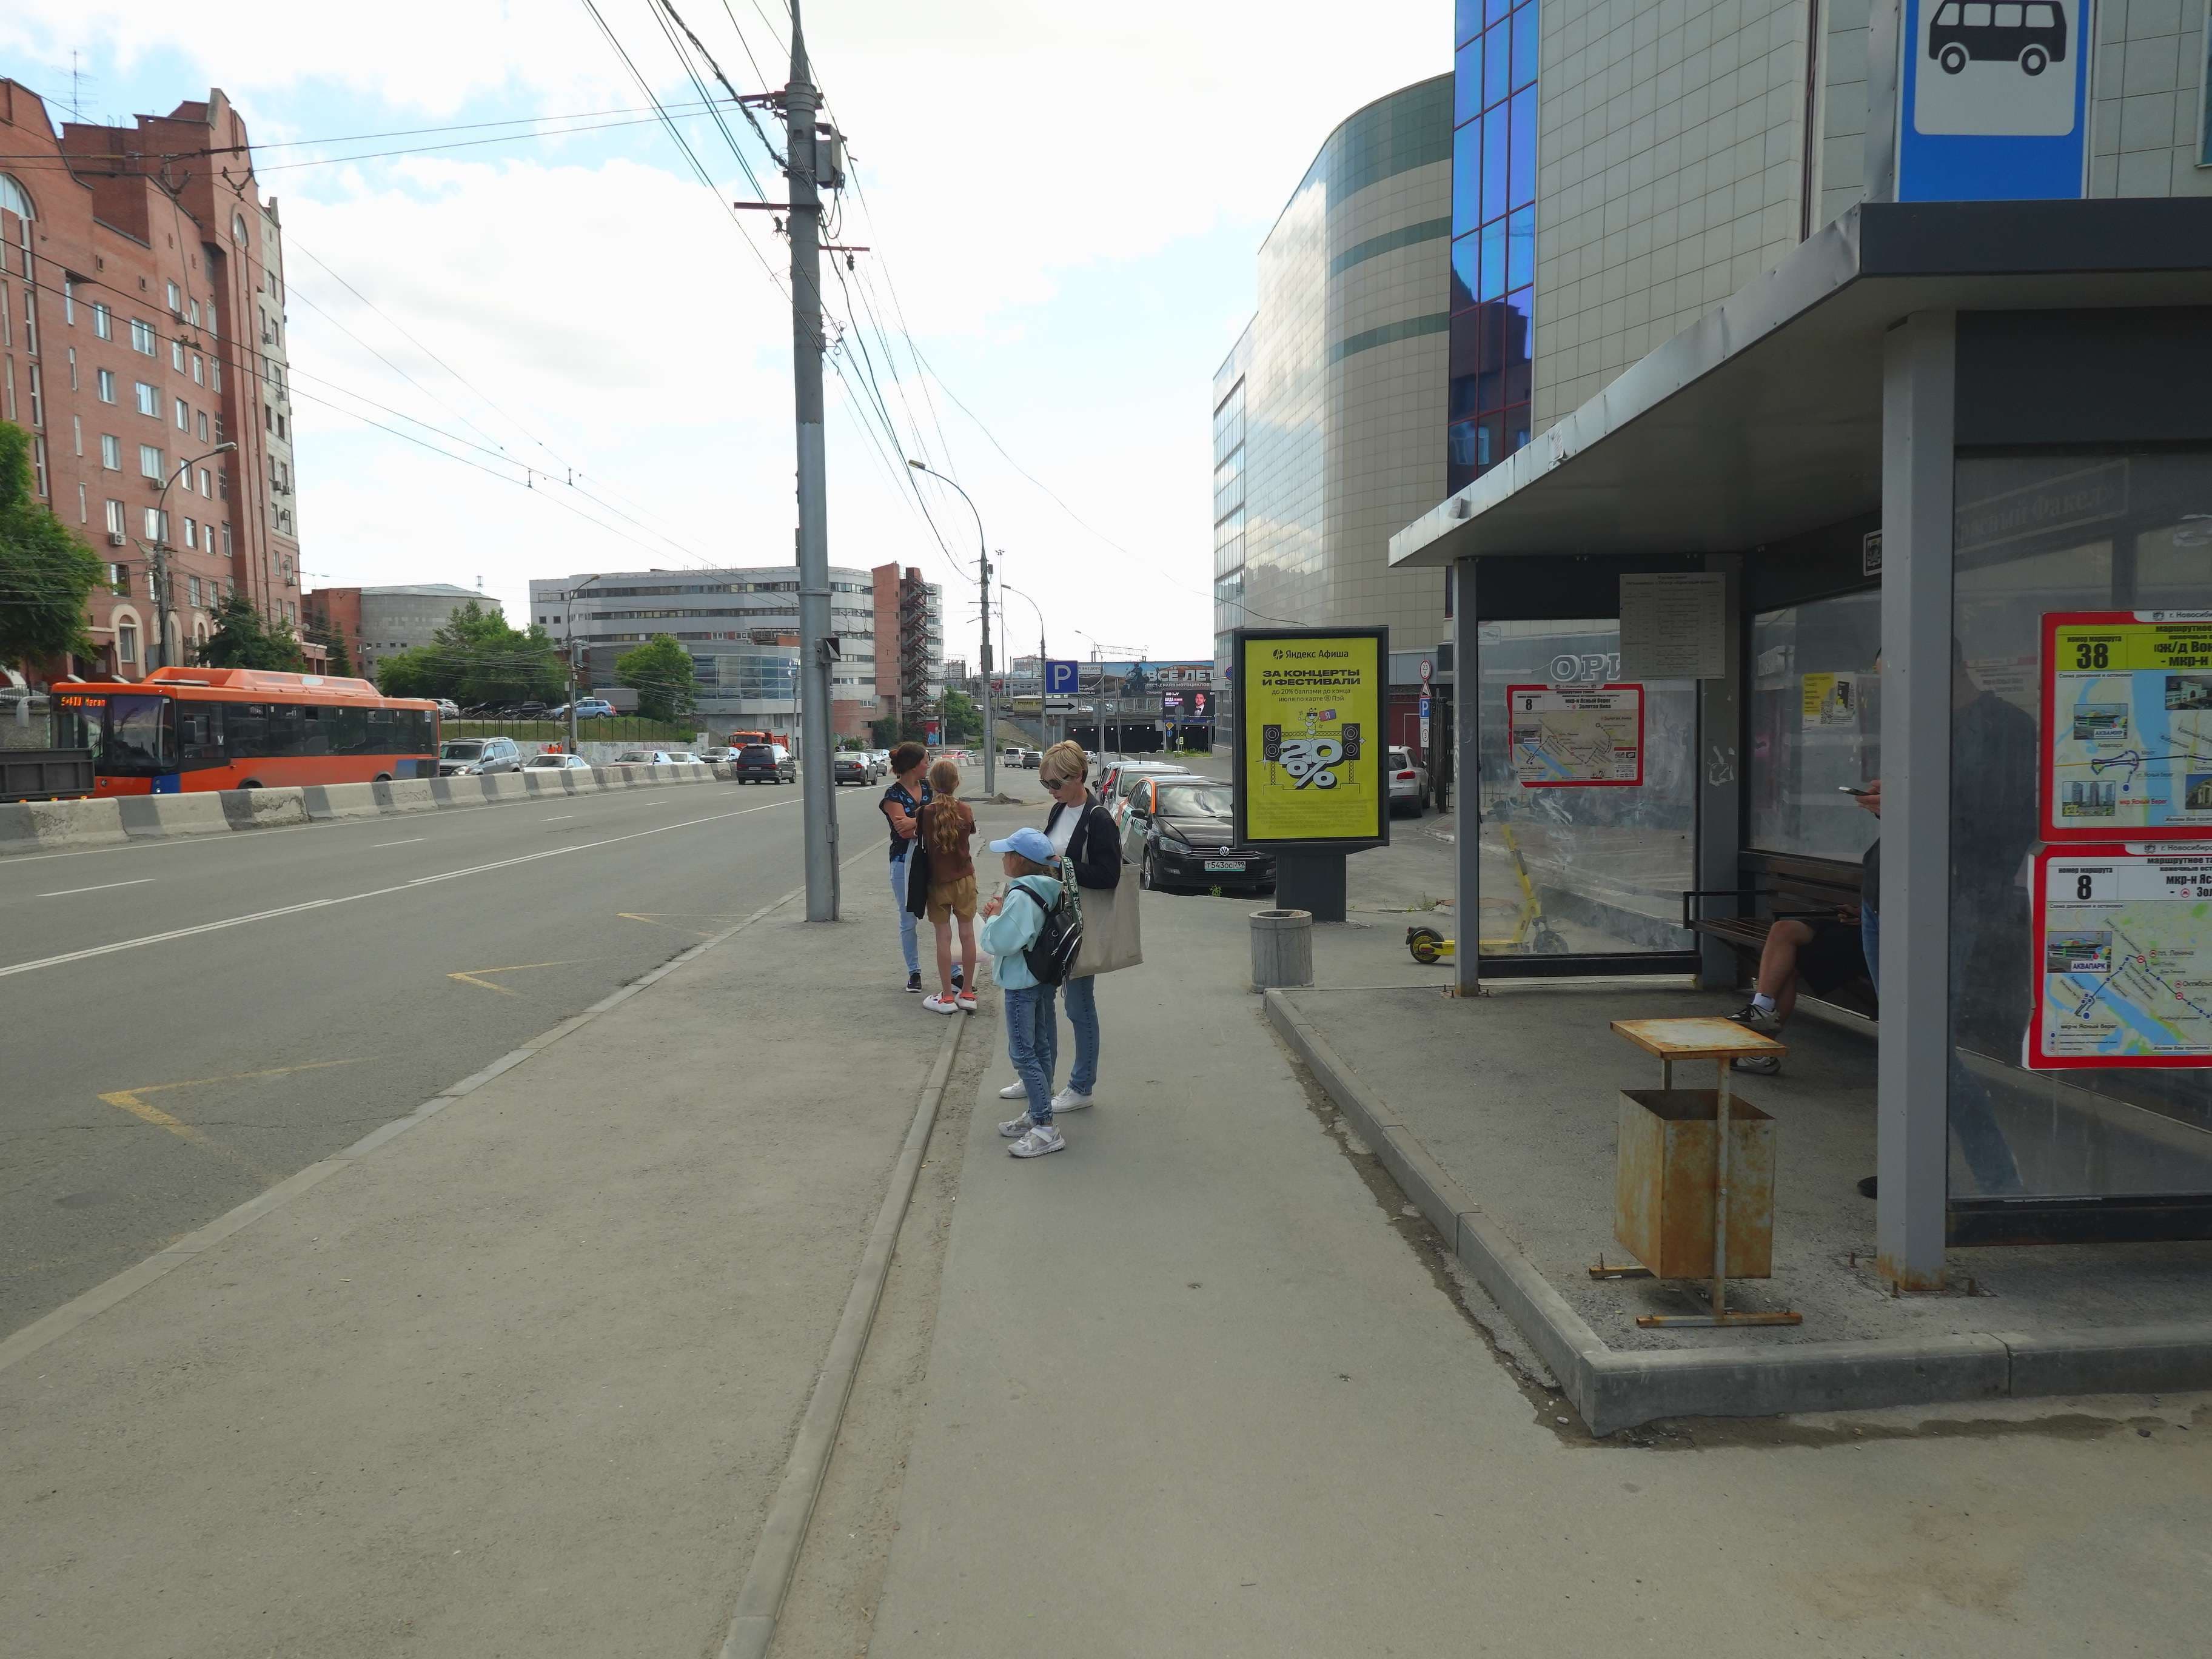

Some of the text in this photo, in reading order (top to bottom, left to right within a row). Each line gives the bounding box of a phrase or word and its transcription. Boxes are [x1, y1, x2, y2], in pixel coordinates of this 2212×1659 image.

[1286, 649, 1349, 659] Яндекс Афиша
[2076, 643, 2108, 669] 38
[2169, 656, 2209, 667] мкр-н
[1054, 665, 1071, 690] P
[1146, 666, 1178, 682] ВСЁ
[1284, 669, 1360, 678] КОНЦЕРТЫ
[1526, 699, 1532, 710] 8
[2166, 876, 2197, 885] мкр-н
[2077, 875, 2092, 900] 8
